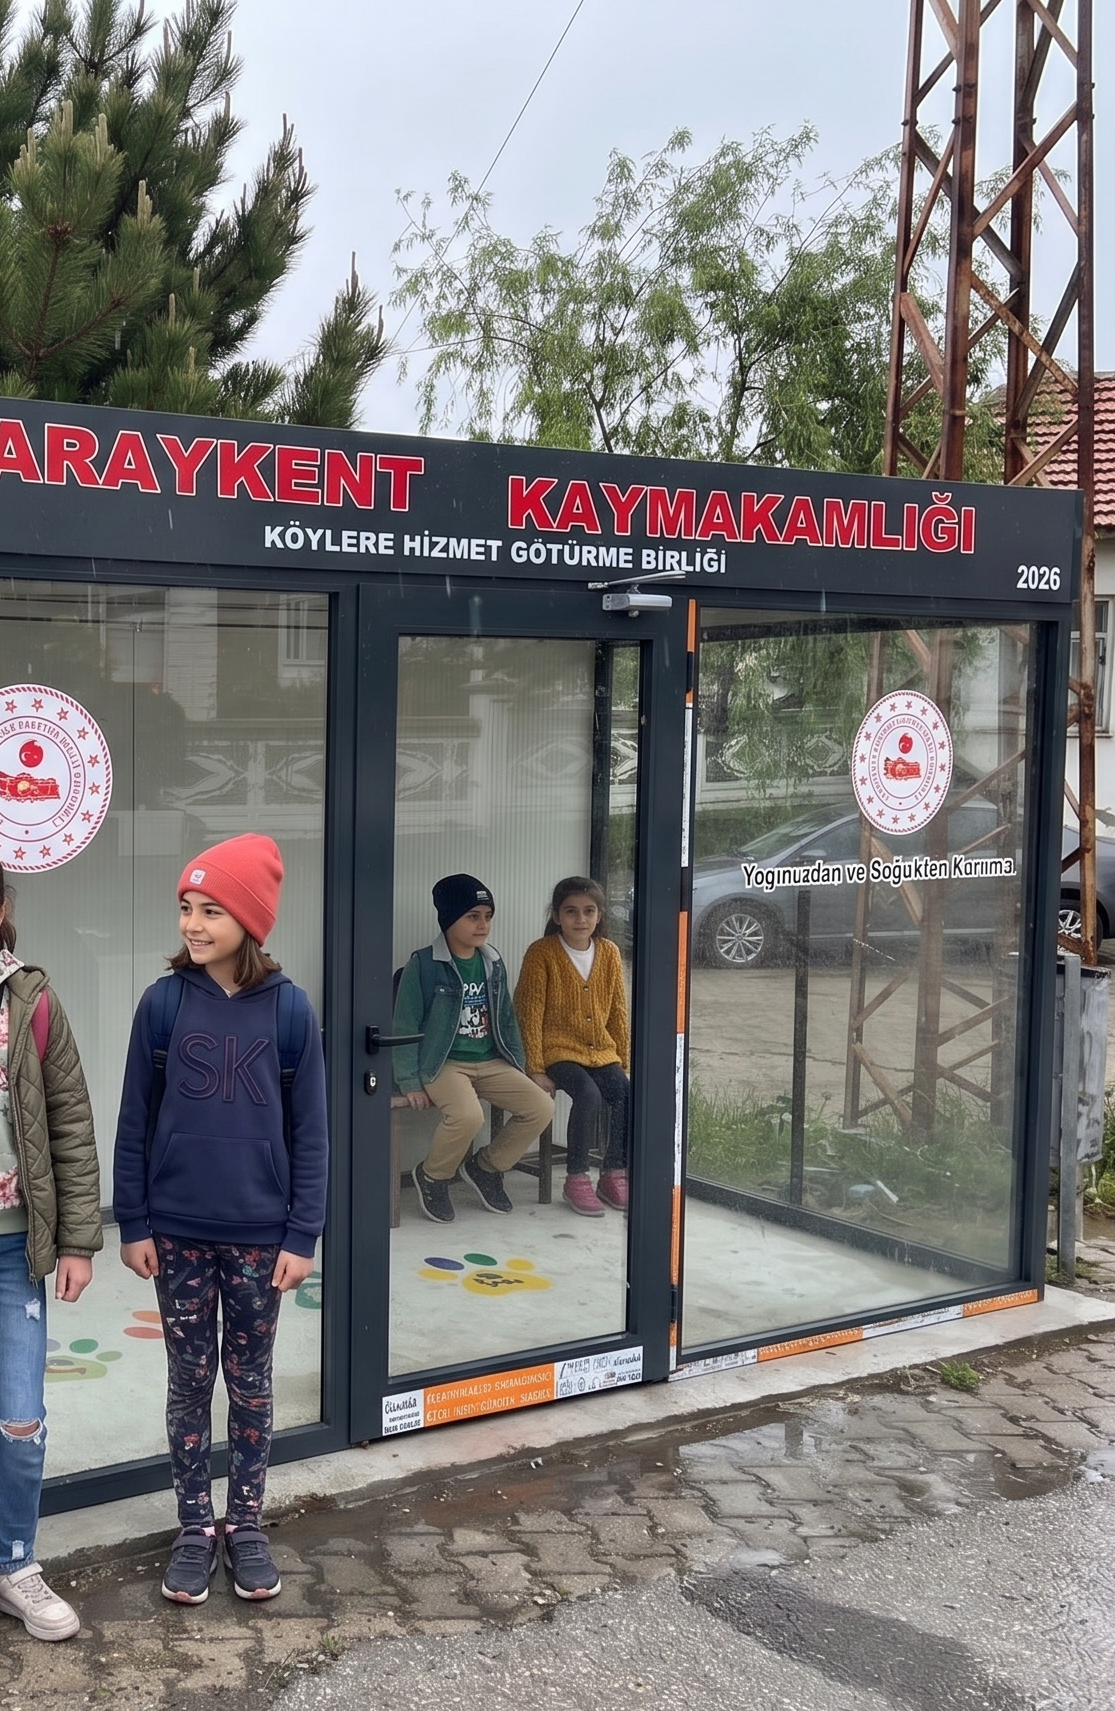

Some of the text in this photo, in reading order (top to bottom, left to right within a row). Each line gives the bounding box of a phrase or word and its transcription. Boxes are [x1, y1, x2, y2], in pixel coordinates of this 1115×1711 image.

[507, 475, 976, 554] KAYMAKAMLIĞI
[264, 521, 727, 573] KÖYLERE HİZMET GÖTÜRME BİRLİĞİ
[1016, 564, 1061, 591] 2026
[846, 866, 866, 881] ve
[871, 857, 947, 885] Soğukten
[177, 1033, 269, 1106] SK
